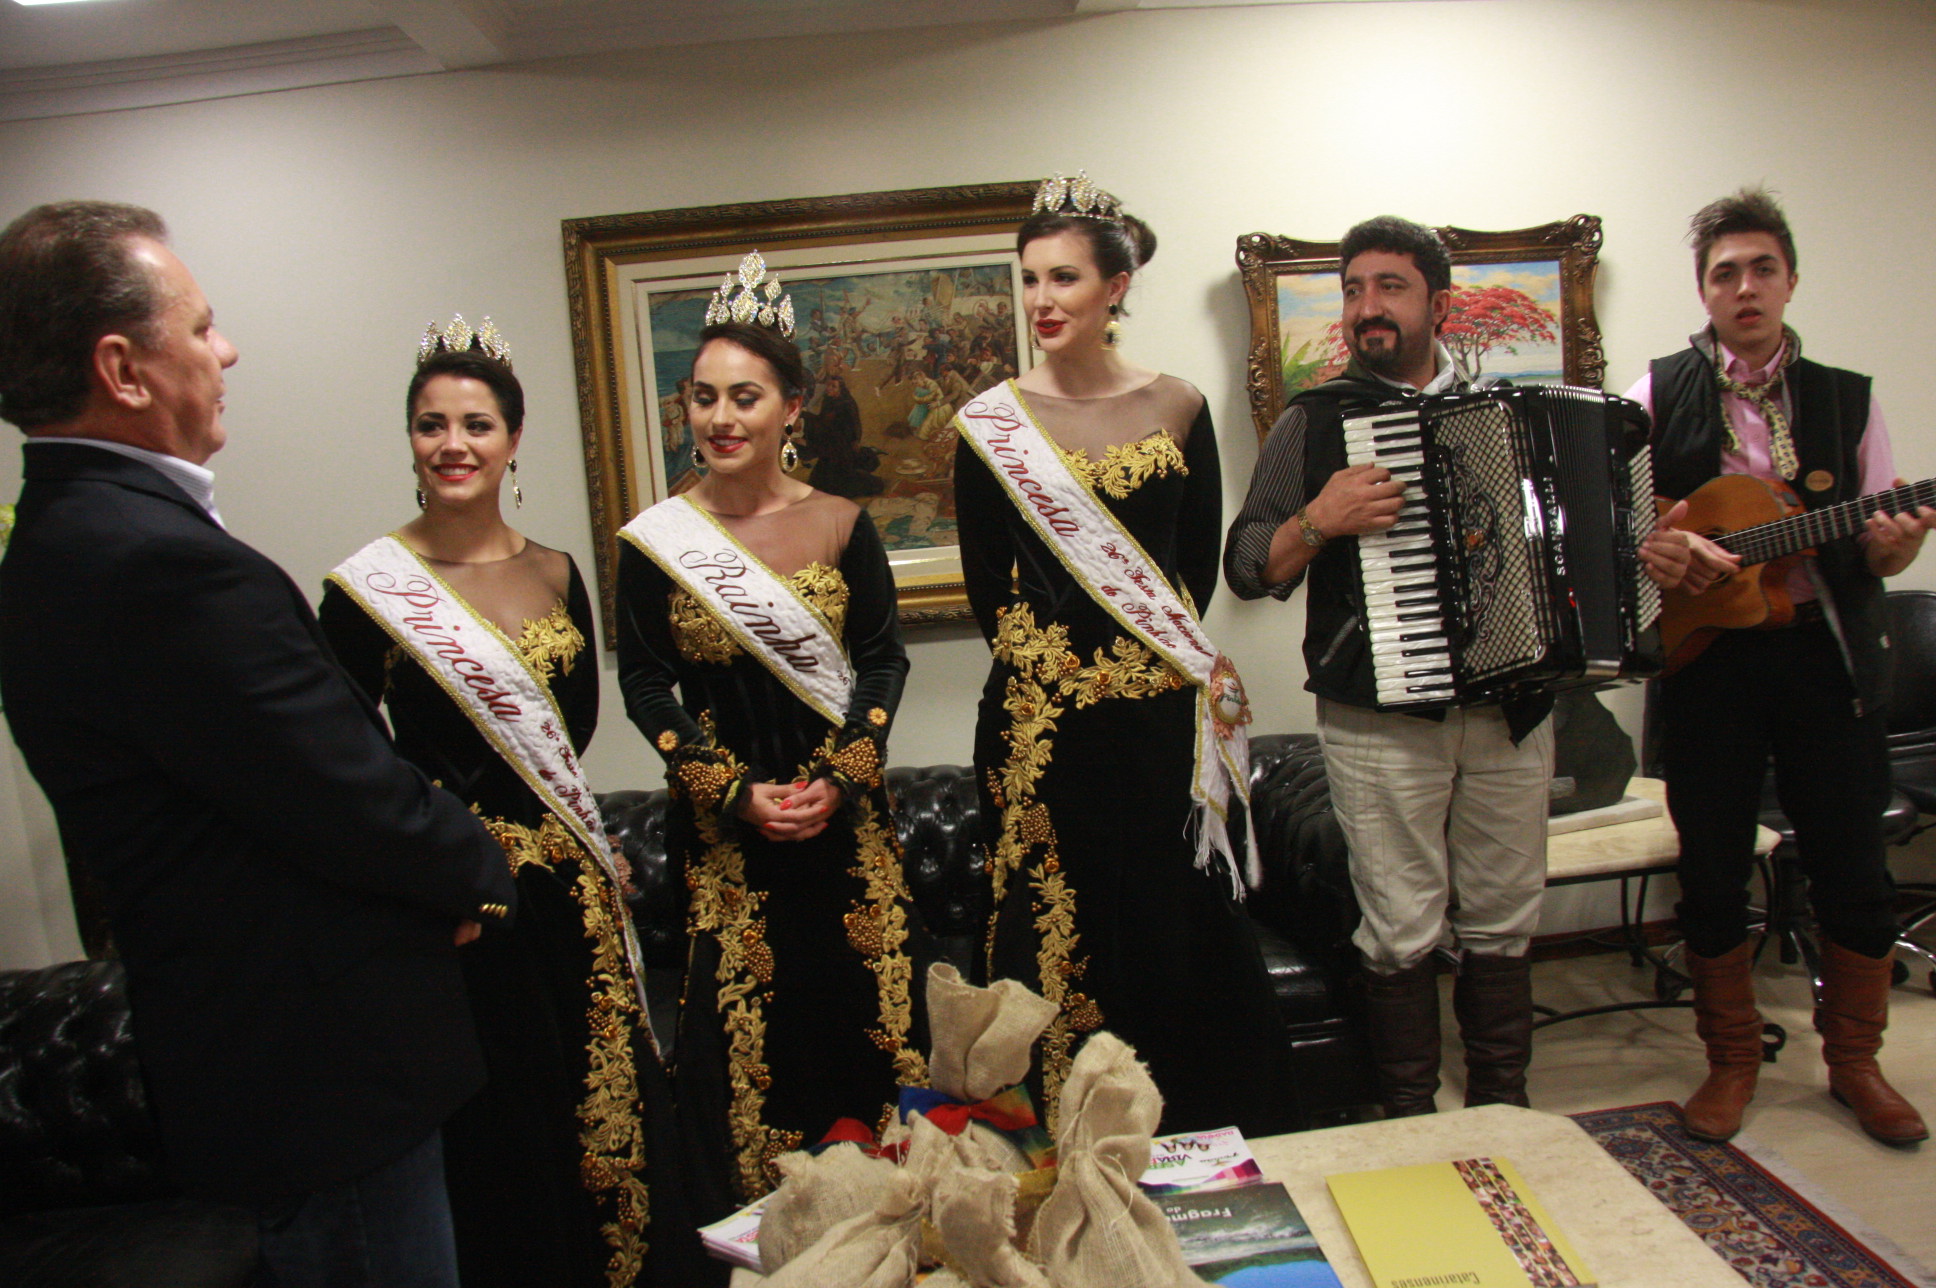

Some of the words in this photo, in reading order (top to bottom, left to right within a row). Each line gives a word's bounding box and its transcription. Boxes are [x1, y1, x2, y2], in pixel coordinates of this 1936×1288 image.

[964, 401, 1083, 538] Princesa
[1543, 475, 1567, 577] SCANDALLI
[365, 571, 522, 723] Princesa
[679, 548, 819, 674] Rainha
[1162, 604, 1214, 659] Nacional
[1390, 1270, 1481, 1288] Catarinenses
